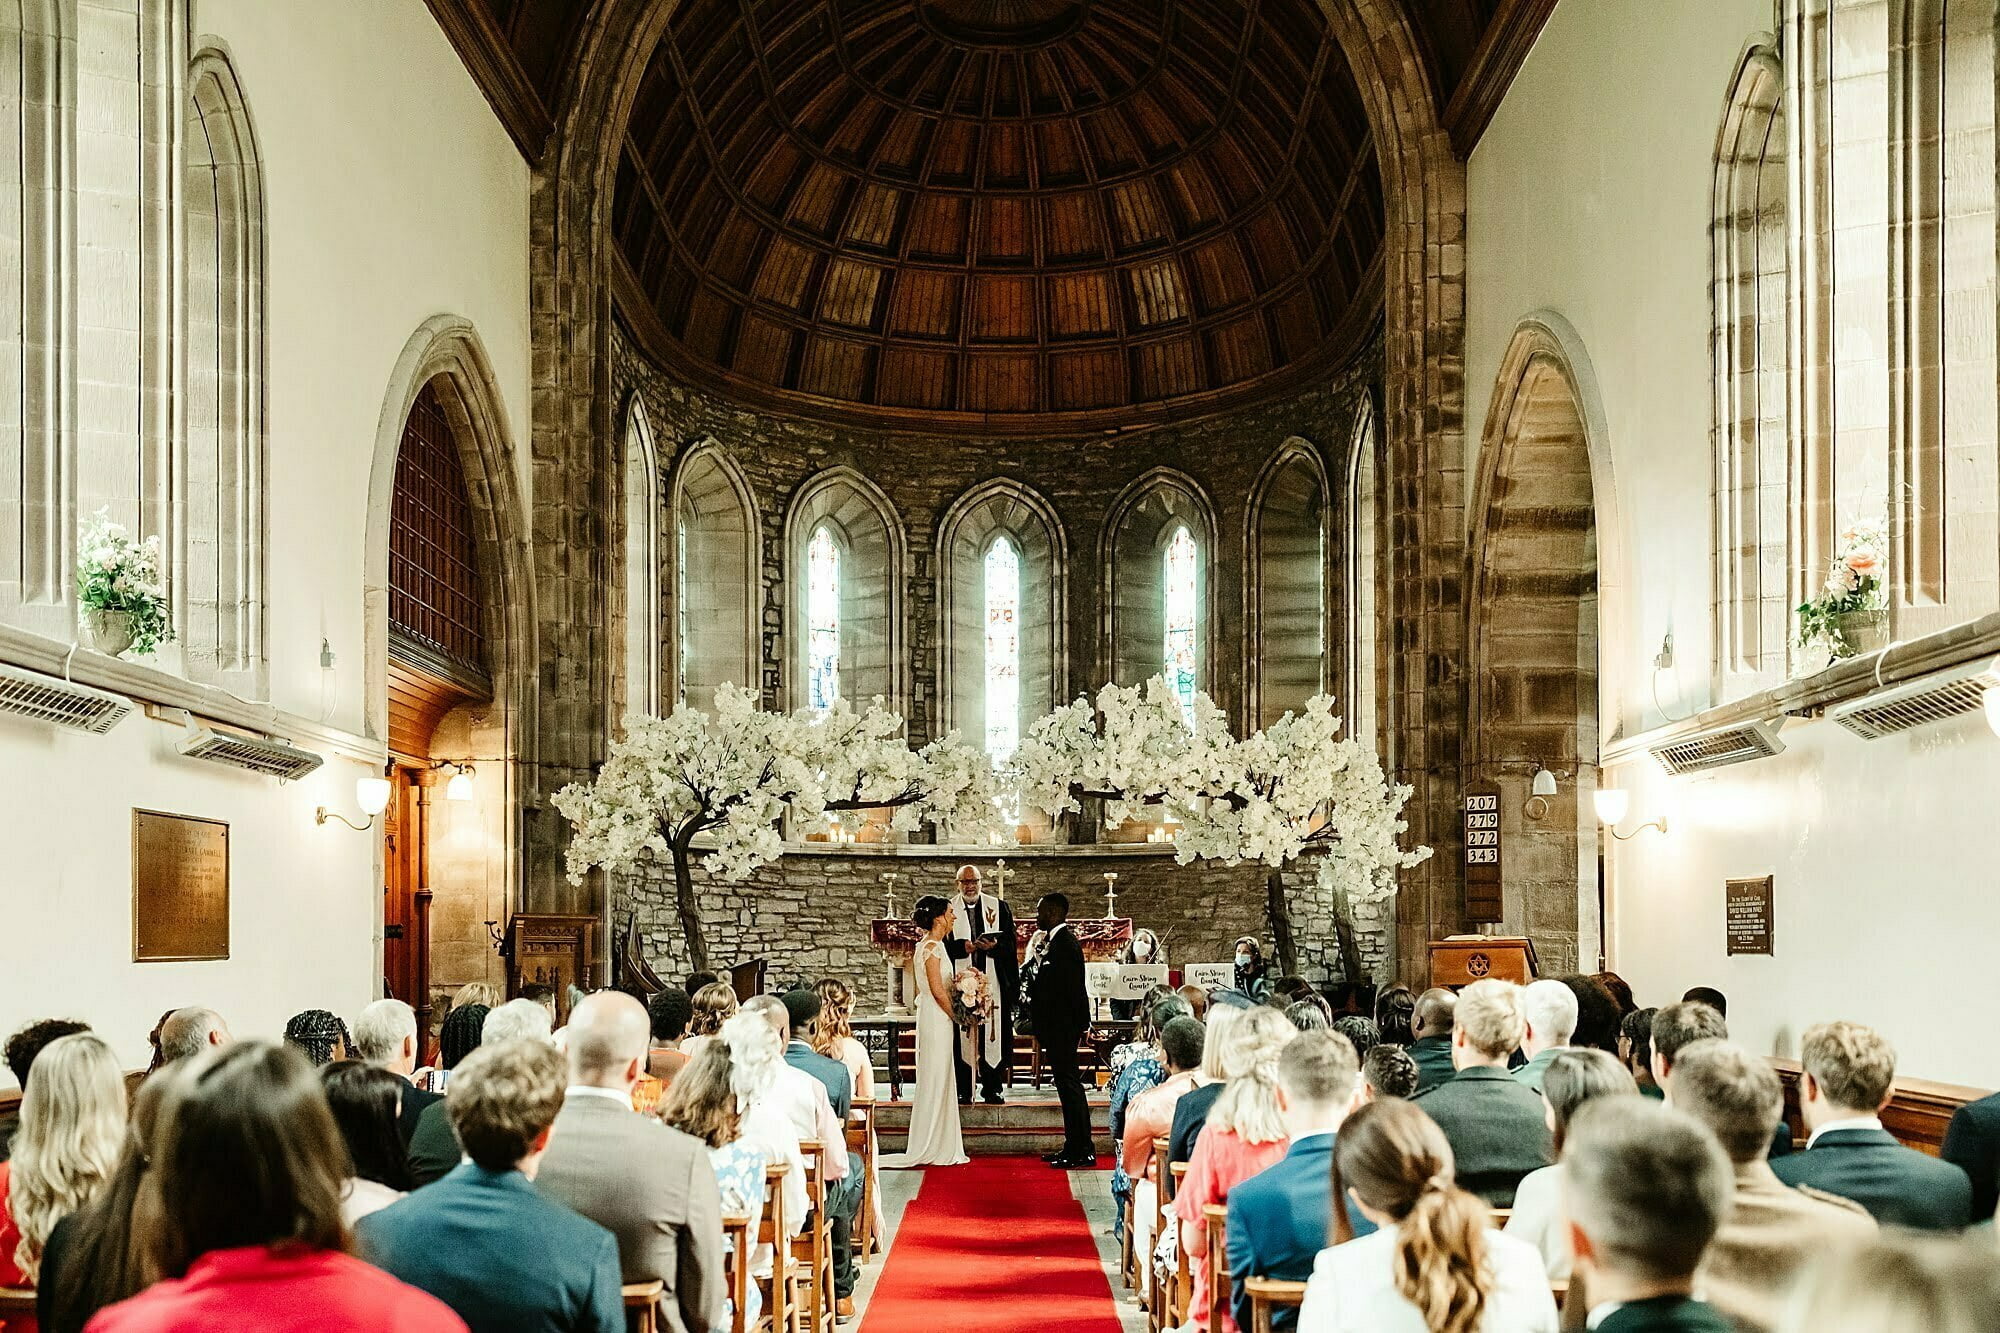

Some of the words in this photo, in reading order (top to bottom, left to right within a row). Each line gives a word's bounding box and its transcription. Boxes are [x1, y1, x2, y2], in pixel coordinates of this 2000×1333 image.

[1468, 797, 1494, 810] 207
[1469, 814, 1496, 827] 279
[1469, 831, 1496, 845] 272
[1469, 849, 1496, 862] 343
[1122, 975, 1139, 984] Cairn
[1139, 974, 1157, 984] String
[1209, 969, 1226, 978] String
[1128, 982, 1150, 991] Quartet
